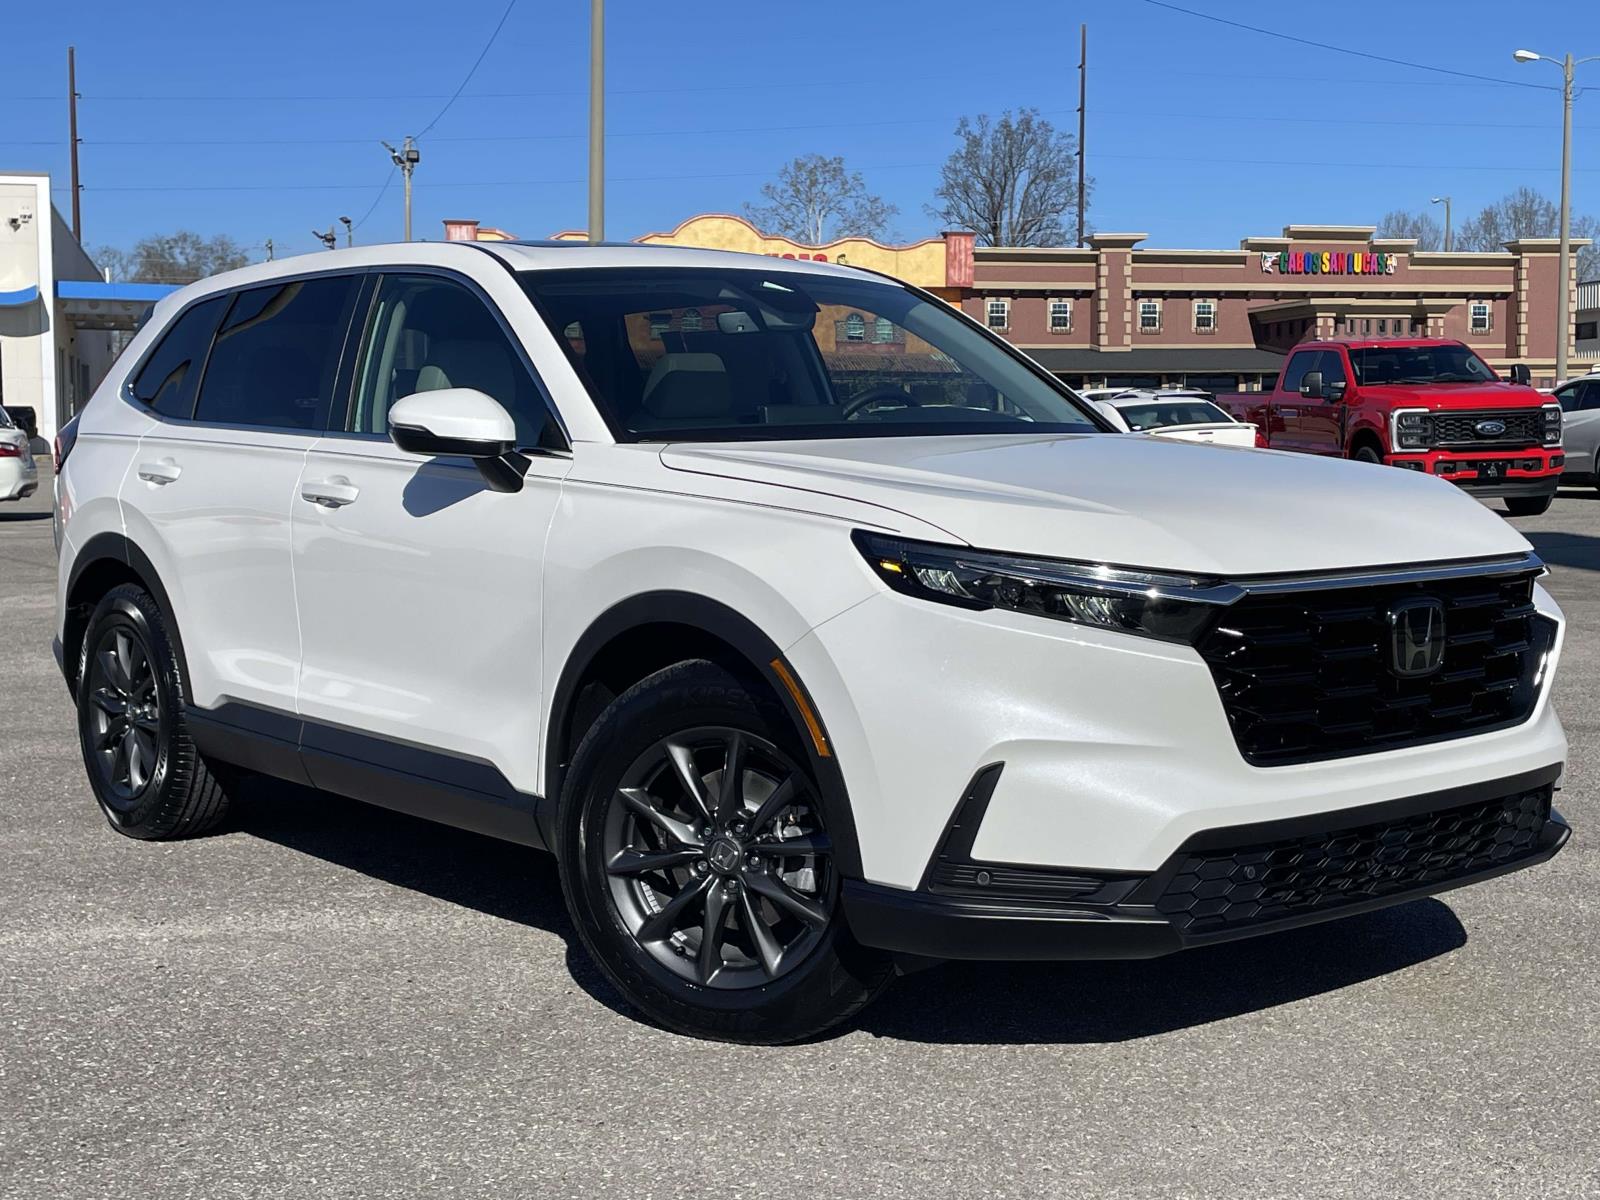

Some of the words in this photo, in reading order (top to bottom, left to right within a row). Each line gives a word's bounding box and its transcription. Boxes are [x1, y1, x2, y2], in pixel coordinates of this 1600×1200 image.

[1279, 252, 1320, 273] CABOS
[1321, 252, 1346, 273] SAN
[1347, 252, 1385, 273] LUCAS
